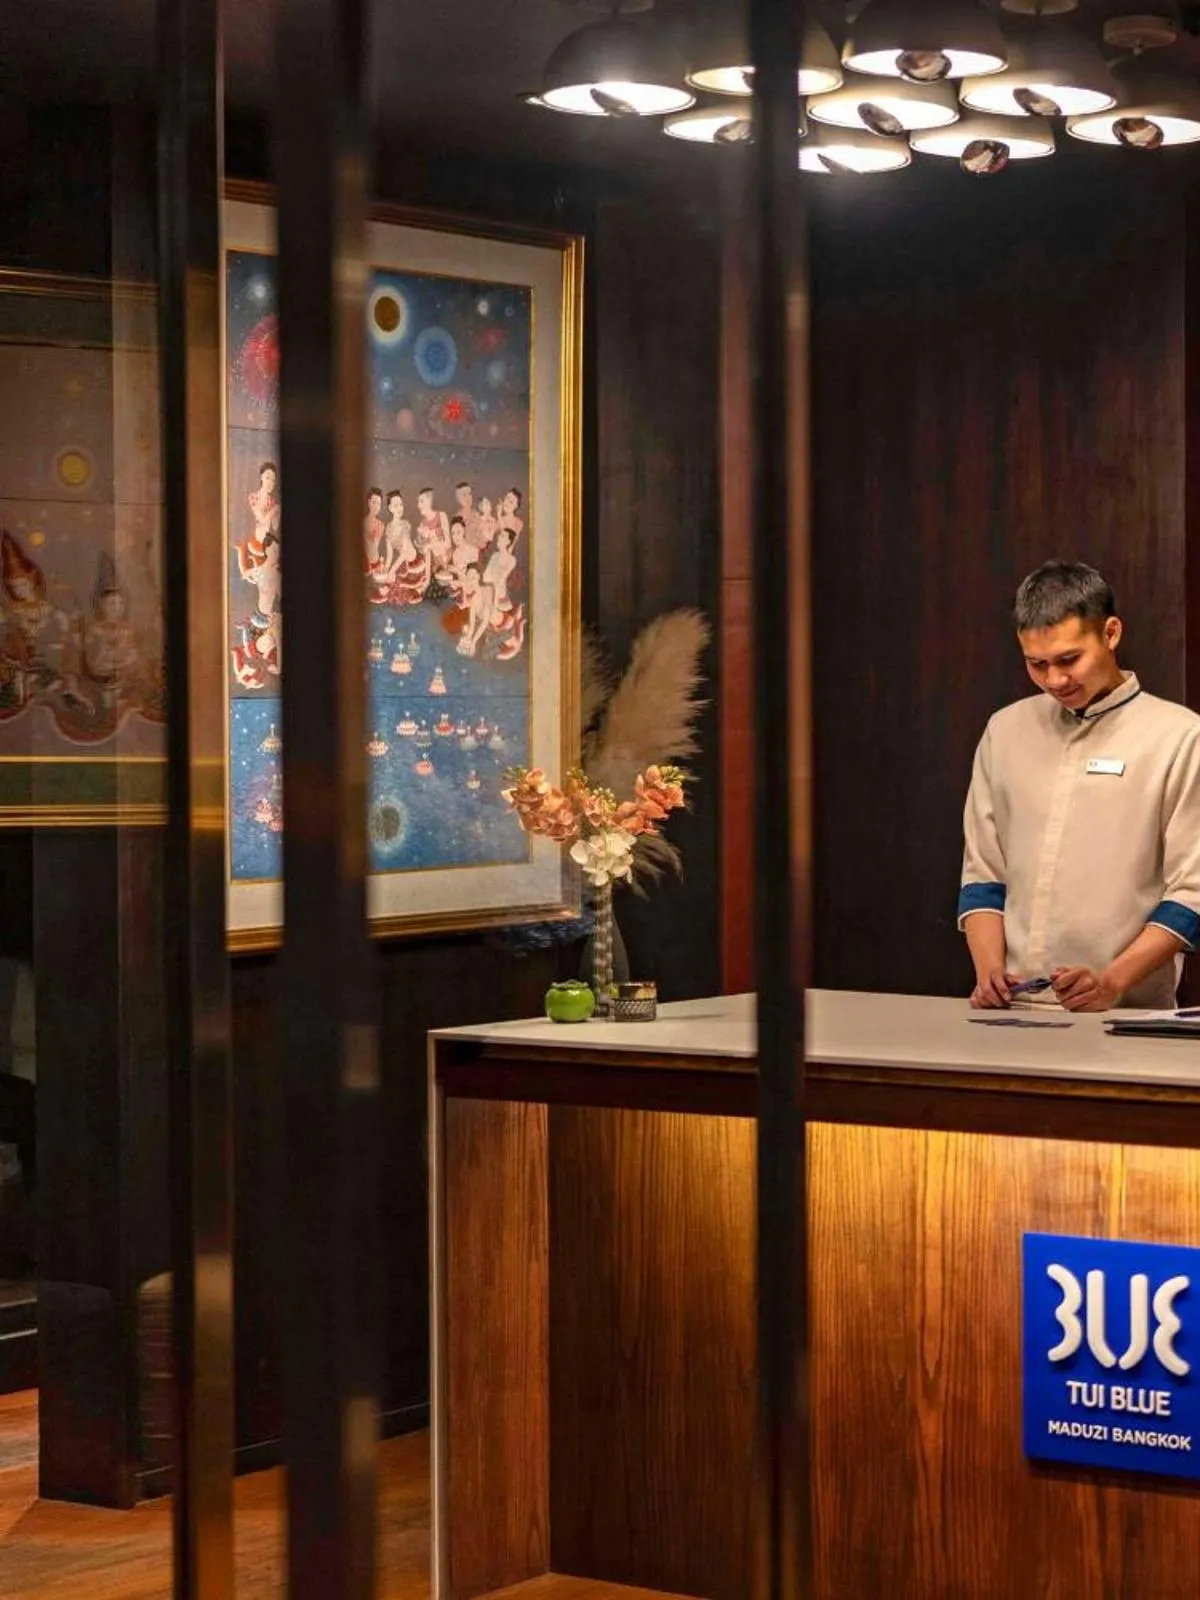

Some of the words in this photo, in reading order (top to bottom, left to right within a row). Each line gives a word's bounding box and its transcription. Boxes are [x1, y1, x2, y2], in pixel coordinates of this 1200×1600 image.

[1066, 1380, 1105, 1409] TUI
[1110, 1386, 1171, 1416] BLUE
[1048, 1420, 1108, 1441] MADUZI
[1112, 1428, 1191, 1450] BANGKOK
